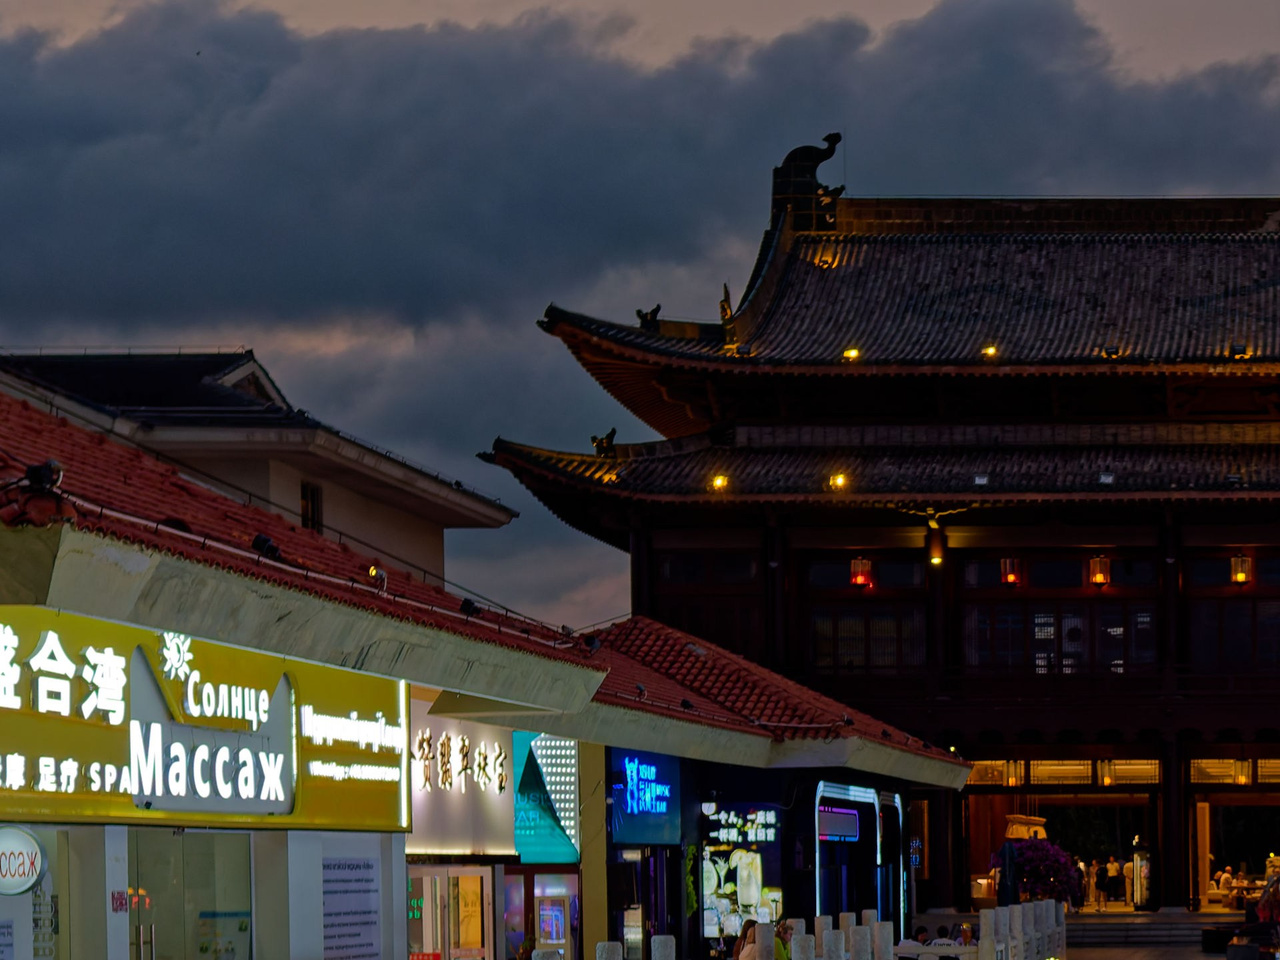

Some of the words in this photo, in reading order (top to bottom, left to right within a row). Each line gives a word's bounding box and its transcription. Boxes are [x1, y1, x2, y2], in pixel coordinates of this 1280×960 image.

[187, 669, 269, 731] Солнце
[39, 757, 78, 793] 足疗
[90, 762, 132, 794] SPA
[130, 719, 285, 801] Массаж
